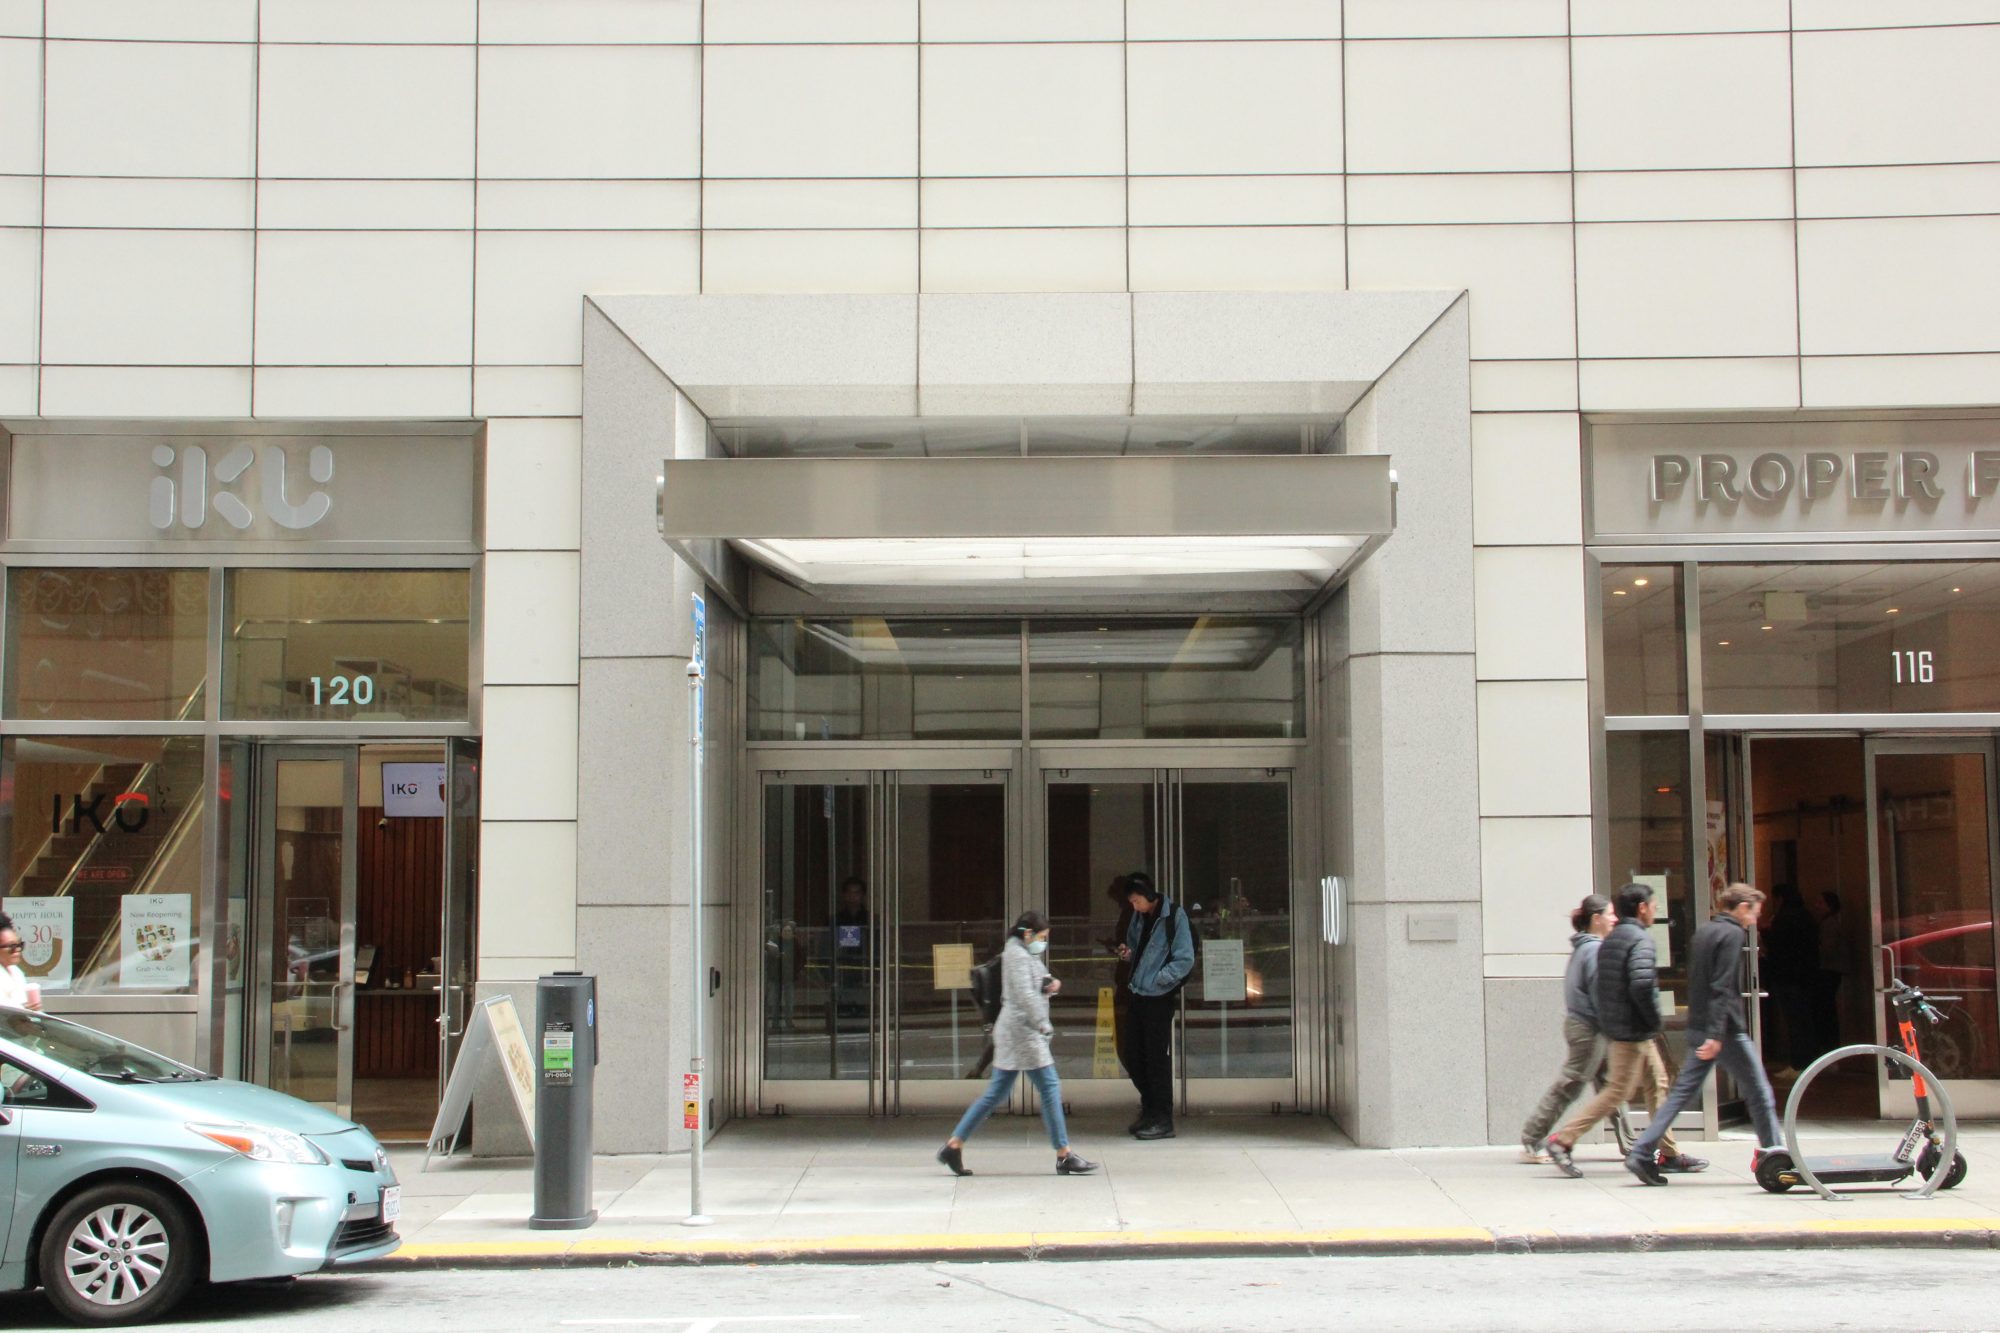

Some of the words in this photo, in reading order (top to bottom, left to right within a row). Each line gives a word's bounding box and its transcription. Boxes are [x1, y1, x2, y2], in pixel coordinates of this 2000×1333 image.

[1650, 452, 1944, 502] PROPER
[1892, 651, 1933, 683] 116
[310, 675, 373, 705] 120
[12, 912, 37, 920] HAPPY
[40, 911, 64, 919] HOUR
[1321, 876, 1340, 945] 100
[28, 924, 52, 944] 30
[1900, 1120, 1928, 1160] 3487383
